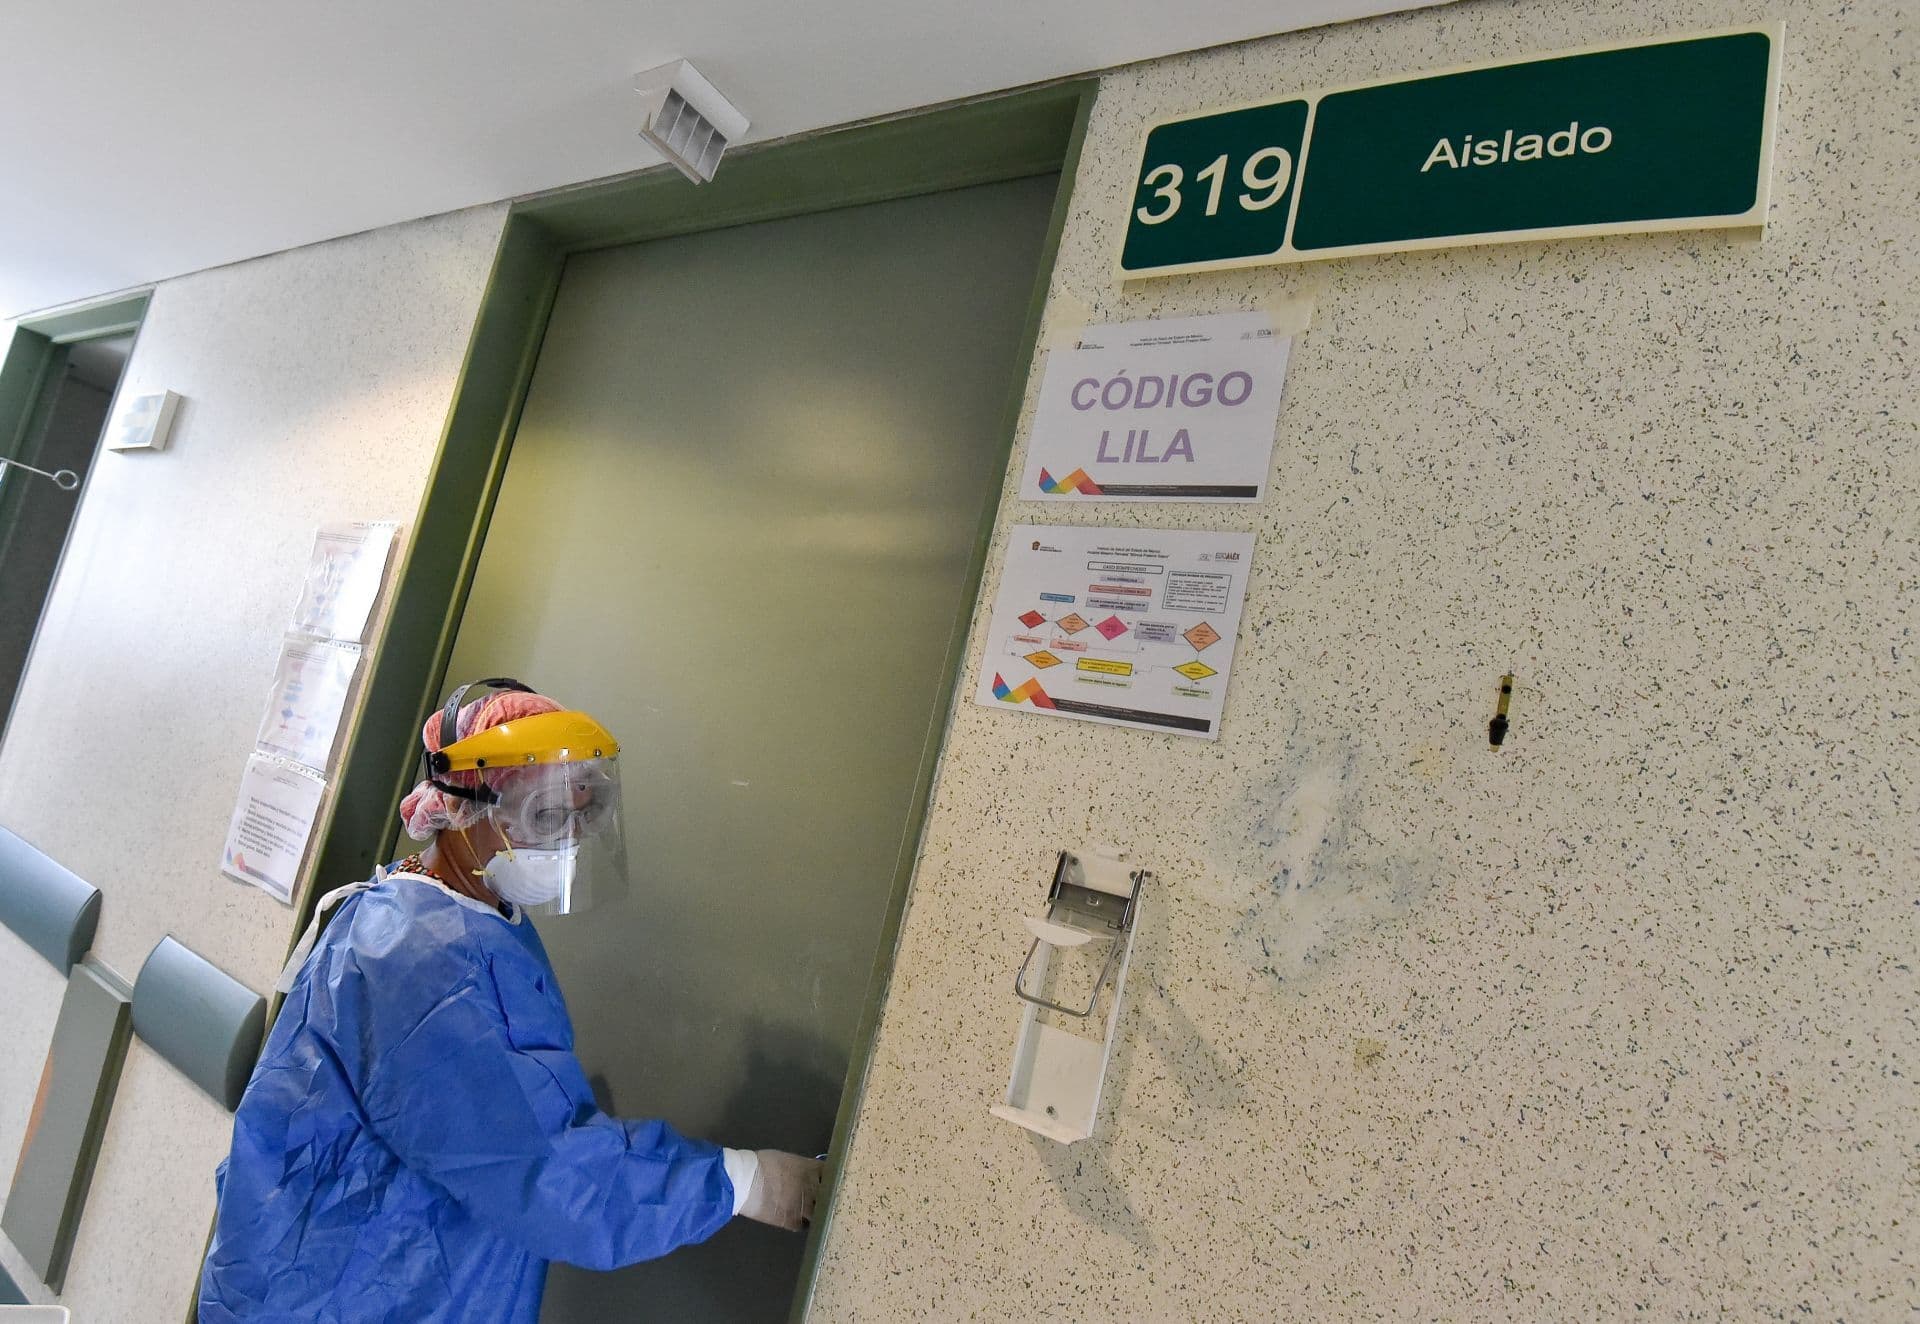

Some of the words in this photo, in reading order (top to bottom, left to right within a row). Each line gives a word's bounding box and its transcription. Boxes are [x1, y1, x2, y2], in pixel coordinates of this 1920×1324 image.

[1420, 121, 1612, 172] Aislado
[1137, 146, 1293, 226] 319
[1071, 369, 1254, 411] CÓDIGO
[1096, 428, 1195, 463] LILA
